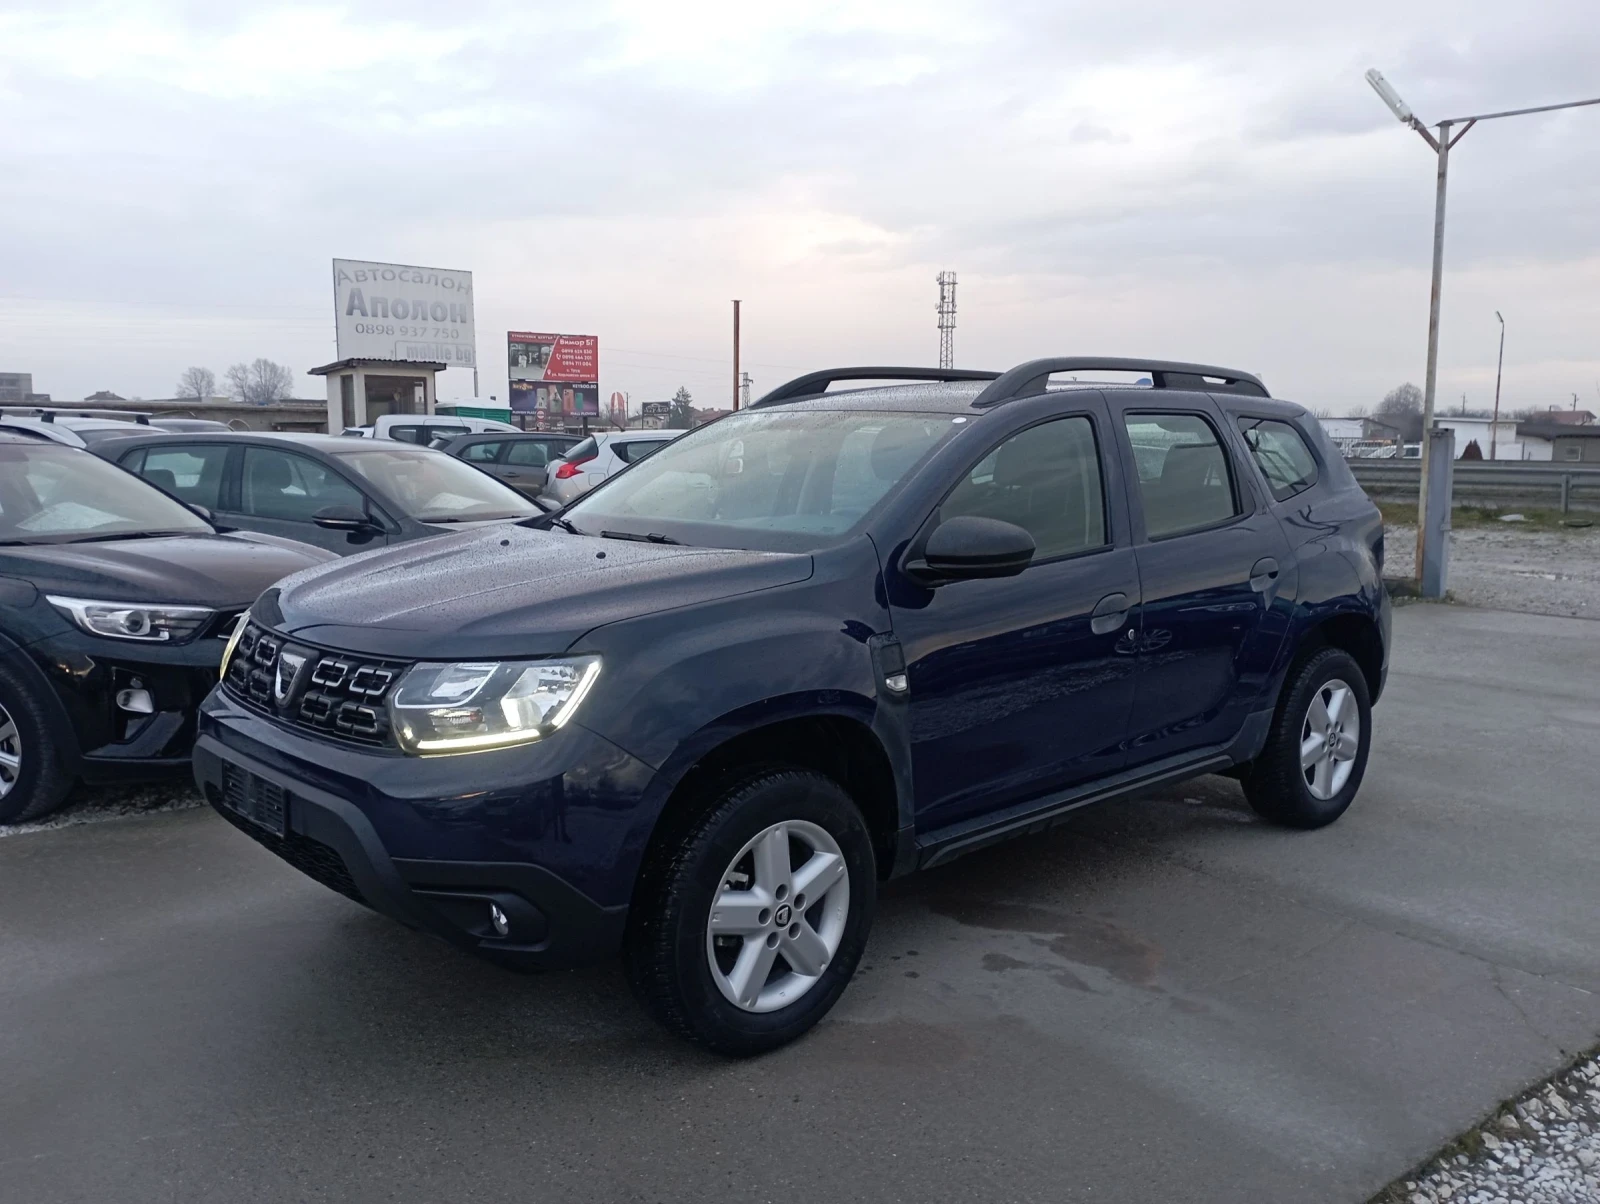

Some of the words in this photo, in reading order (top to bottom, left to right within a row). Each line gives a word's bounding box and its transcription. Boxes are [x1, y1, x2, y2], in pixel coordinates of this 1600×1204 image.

[345, 287, 467, 324] Аполон
[355, 323, 395, 335] 0898
[399, 326, 427, 337] 937
[432, 327, 459, 339] 750
[559, 339, 585, 347] Вимор
[406, 345, 452, 361] mobile
